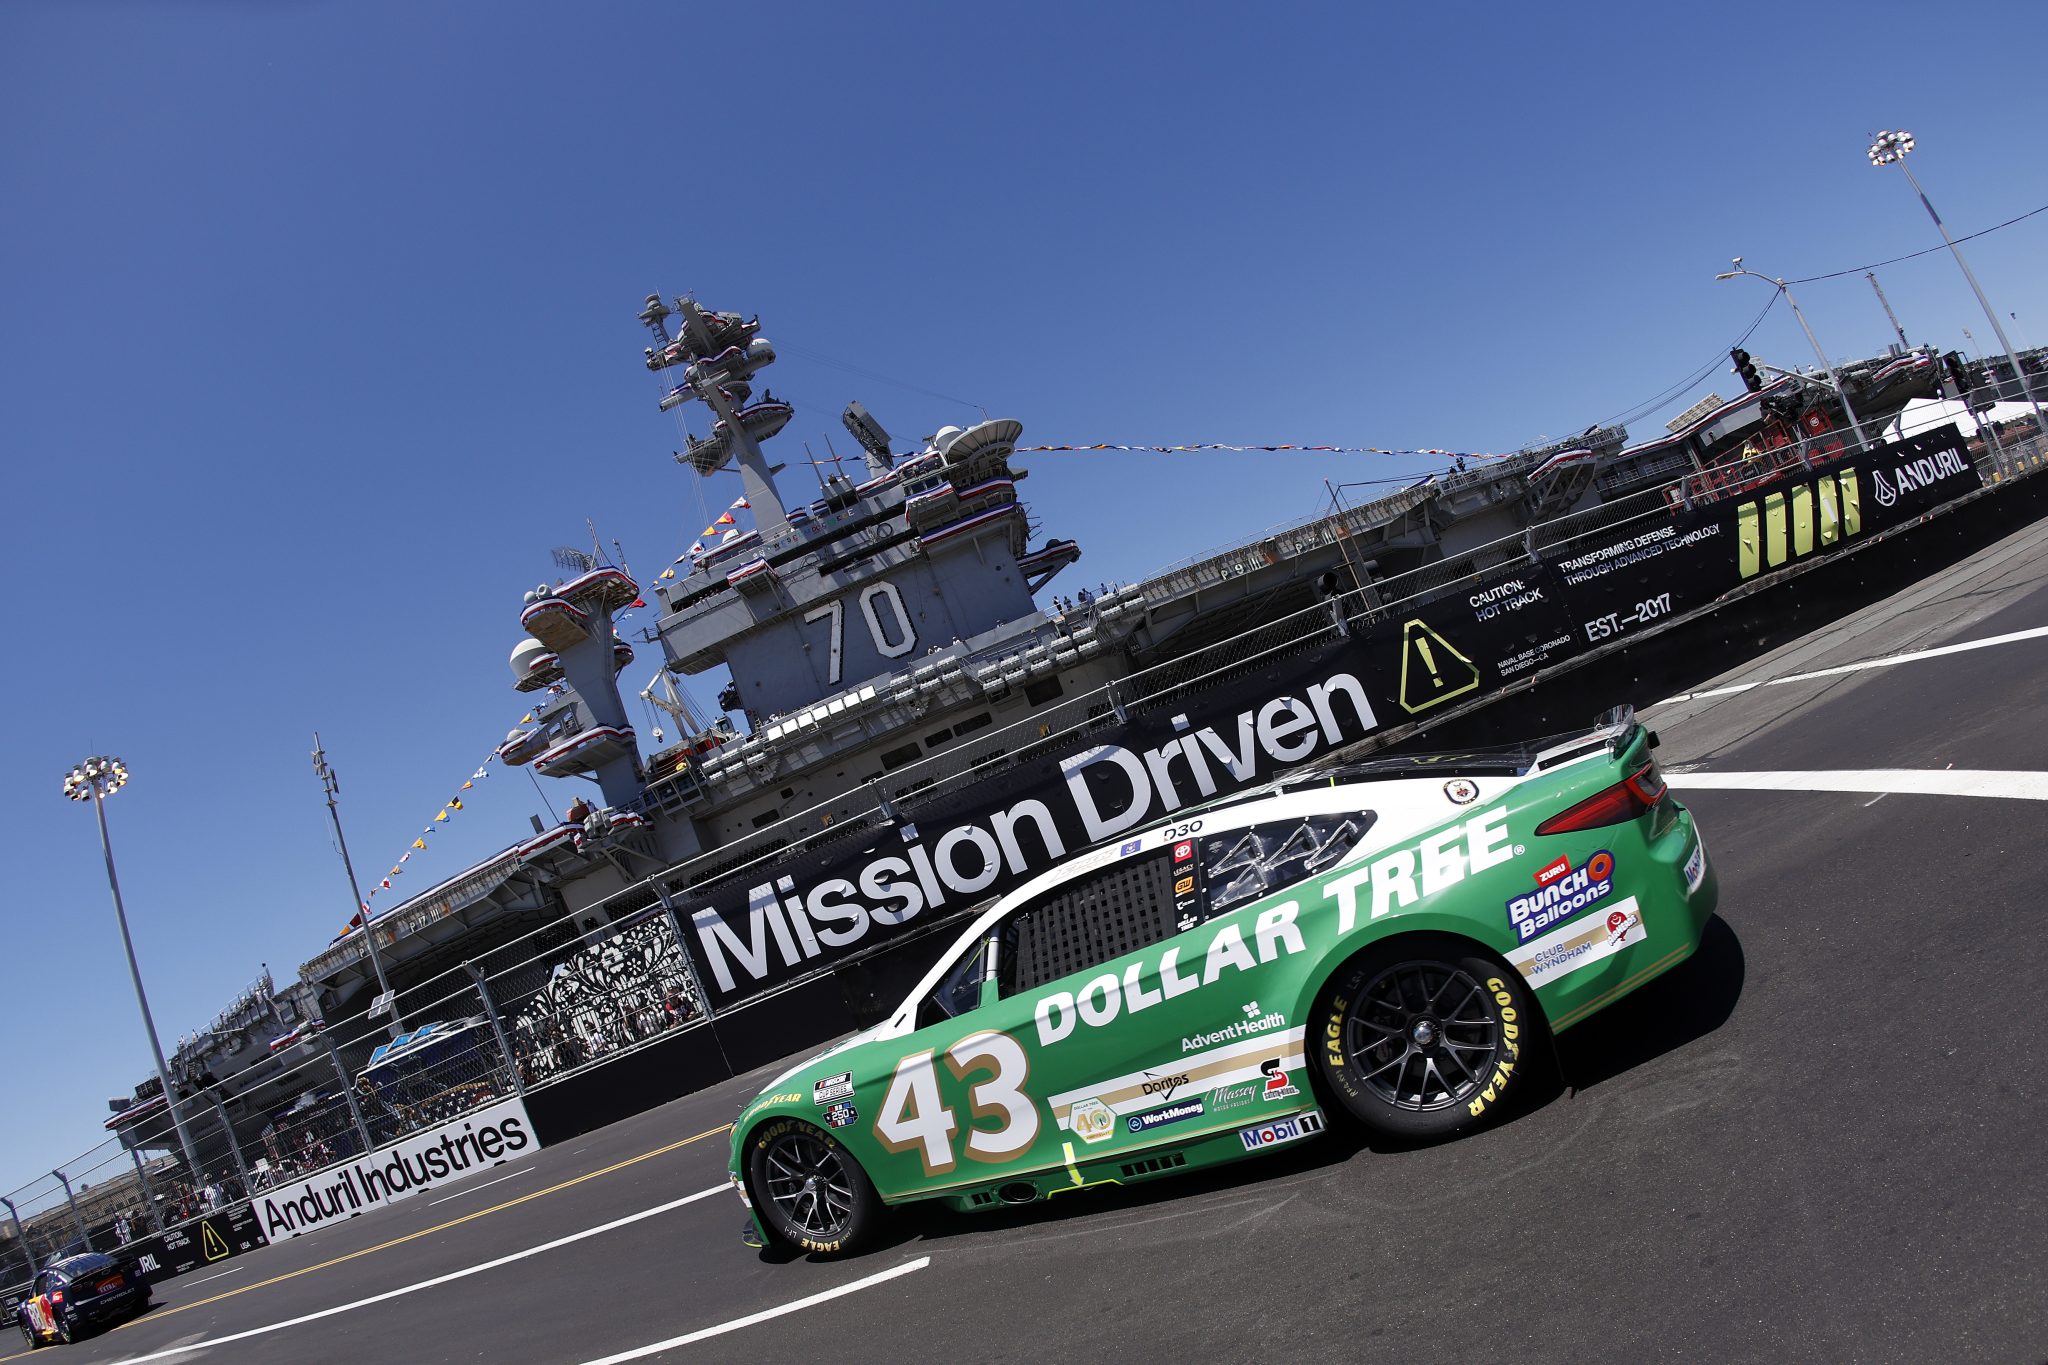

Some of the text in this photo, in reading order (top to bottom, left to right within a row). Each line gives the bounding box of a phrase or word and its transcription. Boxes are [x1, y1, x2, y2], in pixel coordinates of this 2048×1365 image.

[1896, 447, 1969, 495] ANDURIL
[1558, 525, 1675, 573] TRANSFORMING DEFENSE
[1564, 523, 1720, 586] THROUGH ADVANCED TECHNOLOGY
[1469, 579, 1525, 608] CAUTION:
[1475, 588, 1543, 622] HOT TRACK
[803, 581, 917, 686] 70
[1497, 635, 1571, 669] NAVAL BASE CORONADO
[1501, 667, 1514, 677] SAN
[692, 672, 1378, 992] Mission Driven
[1173, 863, 1194, 875] LEGACY
[1538, 863, 1566, 882] ZURU
[1519, 879, 1610, 939] Balloons
[1531, 943, 1592, 974] WYNDHAM
[1534, 943, 1564, 962] CLUB
[1033, 900, 1306, 1047] DOLLAR
[1327, 995, 1347, 1067] EAGLE
[1467, 977, 1520, 1117] GOODYEAR
[1141, 1073, 1190, 1096] Doritos
[1205, 1085, 1257, 1107] Massey
[831, 1109, 850, 1121] 250
[874, 1029, 1041, 1176] 43
[1142, 1102, 1203, 1125] WorkMoney
[758, 1119, 835, 1149] GOODYEAR
[1242, 1114, 1317, 1149] Mobil 1
[264, 1117, 528, 1237] Anduril Industries
[176, 1237, 191, 1249] TRACK
[240, 1241, 251, 1250] USA
[801, 1237, 840, 1252] EAGLE
